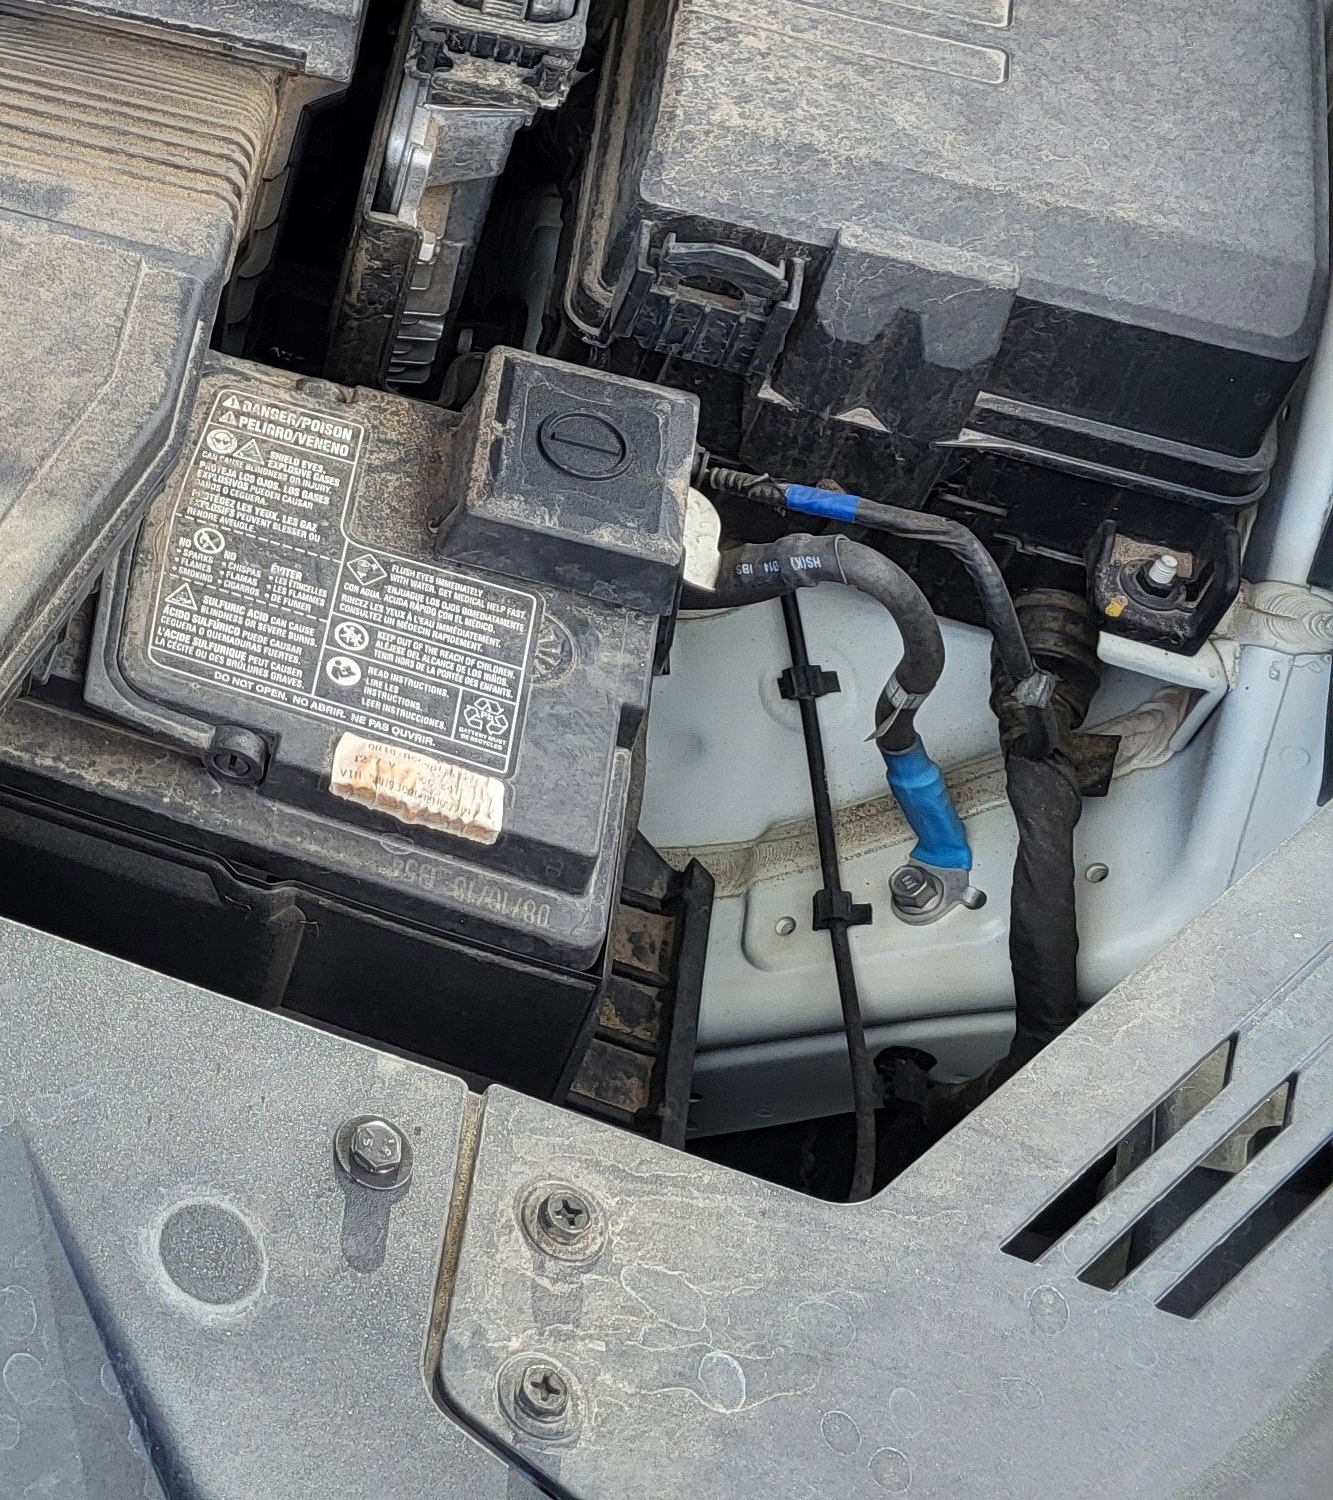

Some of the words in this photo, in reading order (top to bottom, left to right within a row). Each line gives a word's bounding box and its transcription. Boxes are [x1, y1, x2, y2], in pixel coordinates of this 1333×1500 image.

[242, 401, 352, 441] DANGER/POISON
[239, 416, 349, 456] PELIGRO/VENENO
[202, 451, 218, 460] CAN
[270, 451, 300, 466] SHIELD
[302, 460, 326, 474] EYES.
[268, 461, 312, 480] EXPLOSIVE
[313, 472, 340, 487] GASES
[197, 470, 249, 490] EXPLOSIVOS
[250, 484, 280, 501] PUEDEN
[282, 494, 313, 510] CAUSAR
[239, 472, 255, 484] LOS
[257, 476, 281, 491] OJOS.
[284, 484, 300, 498] LOS
[302, 489, 330, 505] GASES
[237, 500, 253, 513] LES
[255, 505, 280, 521] YEUX.
[282, 515, 299, 527] LES
[300, 520, 318, 532] GAZ
[237, 512, 271, 529] PEUVENT
[179, 537, 191, 548] NO
[181, 557, 212, 573] FLAMES
[183, 549, 214, 564] SPARKS
[224, 550, 237, 561] NO
[178, 566, 213, 583] SMOKING
[226, 571, 258, 586] FLAMAS
[228, 562, 261, 578] CHISPAS
[275, 576, 287, 586] LES
[392, 564, 415, 578] FLUSH
[416, 570, 434, 583] EYES
[223, 579, 260, 596] CIGARROS
[273, 585, 287, 596] LES
[288, 589, 325, 606] FLAMMES
[390, 574, 409, 587] WITH
[410, 579, 436, 594] WATER.
[438, 587, 452, 599] GET
[454, 591, 485, 608] MEDICAL
[487, 600, 506, 613] HELP
[507, 605, 527, 620] FAST.
[203, 595, 246, 614] SULFURIC
[247, 608, 269, 623] ACID
[271, 616, 287, 627] CAN
[288, 621, 315, 636] CAUSE
[271, 594, 282, 603] DE
[283, 597, 312, 613] FUMER
[344, 582, 359, 593] CON
[383, 594, 408, 609] ACUDA
[438, 609, 453, 621] CON
[455, 613, 464, 624] EL
[370, 601, 384, 613] LES
[385, 605, 406, 619] YEUX
[426, 595, 440, 608] LOS
[442, 600, 461, 613] OJOS
[163, 604, 190, 621] ÁCIDO
[192, 614, 241, 635] SULFÚRICO
[242, 630, 268, 644] PUEDE
[269, 638, 303, 655] CAUSAR
[201, 605, 243, 626] BLINDNESS
[245, 618, 256, 629] OR
[258, 622, 287, 637] SEVERE
[288, 632, 317, 647] BURNS.
[339, 603, 382, 622] CONSULTEZ
[384, 615, 395, 626] UN
[432, 632, 483, 652] RAPIDEMENT.
[157, 626, 191, 643] L'ACIDE
[194, 637, 247, 661] SULFURIQUE
[248, 653, 269, 668] PEUT
[270, 660, 303, 678] CAUSER
[161, 616, 196, 633] CEGUERA
[207, 629, 262, 653] QUEMADURAS
[263, 646, 301, 665] FUERTES.
[155, 636, 165, 646] LA
[196, 649, 207, 659] OU
[209, 653, 225, 665] DES
[270, 670, 304, 689] GRAVES.
[377, 631, 395, 643] KEEP
[397, 637, 411, 647] OUT
[413, 641, 423, 650] OF
[424, 644, 438, 654] THE
[439, 648, 464, 662] REACH
[465, 656, 476, 665] OF
[477, 659, 515, 679] CHILDREN.
[407, 650, 420, 660] DEL
[422, 654, 455, 671] ALCANCE
[456, 664, 466, 673] DE
[467, 667, 482, 677] LOS
[214, 671, 230, 682] DO
[232, 675, 254, 691] NOT
[256, 682, 287, 701] OPEN.
[366, 676, 383, 689] LIRE
[384, 683, 399, 694] LES
[368, 666, 389, 679] READ
[390, 673, 449, 698] INSTRUCTIONS.
[374, 649, 394, 662] TENIR
[395, 655, 414, 668] HORS
[416, 661, 425, 671] DE
[426, 664, 435, 674] LA
[465, 675, 478, 686] DES
[480, 680, 513, 698] ENFANTS.
[292, 693, 308, 707] NO
[310, 701, 346, 718] ABRIR.
[364, 686, 423, 711] INSTRUCTIONS.
[351, 713, 367, 725] NE
[368, 718, 389, 732] PAS
[361, 697, 382, 710] LEER
[382, 703, 446, 730] INSTRUCCIONES.
